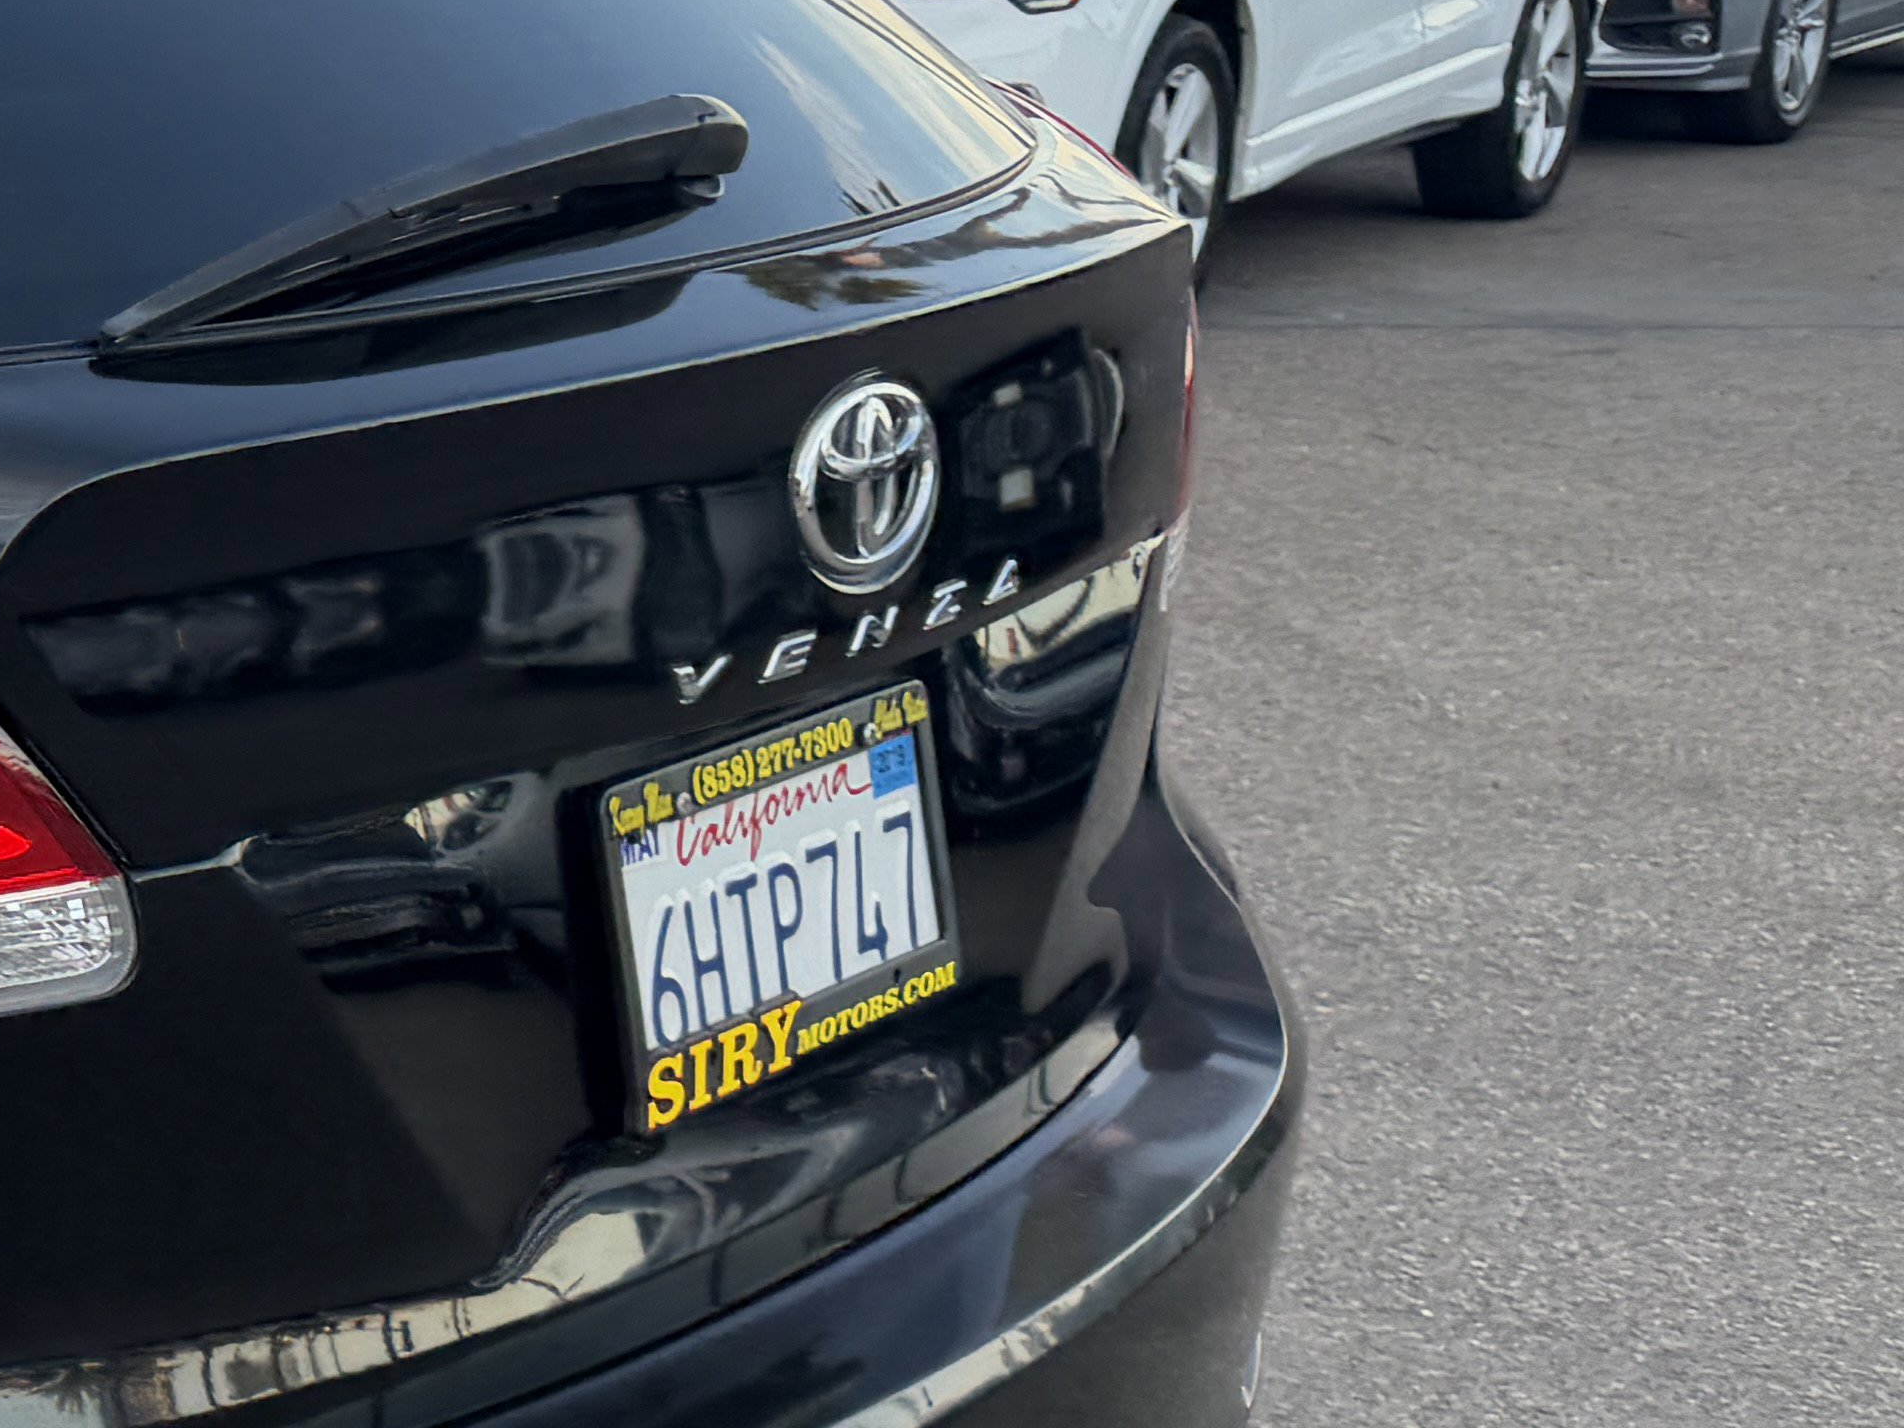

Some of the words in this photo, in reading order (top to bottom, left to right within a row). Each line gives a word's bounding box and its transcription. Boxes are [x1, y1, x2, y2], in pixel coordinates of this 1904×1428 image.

[671, 557, 1021, 706] VENZA
[676, 762, 873, 866] California
[692, 749, 756, 806] (858)
[648, 808, 925, 1050] 6HTP747
[647, 996, 803, 1132] SIRY
[796, 960, 958, 1058] MOTORS.COM
